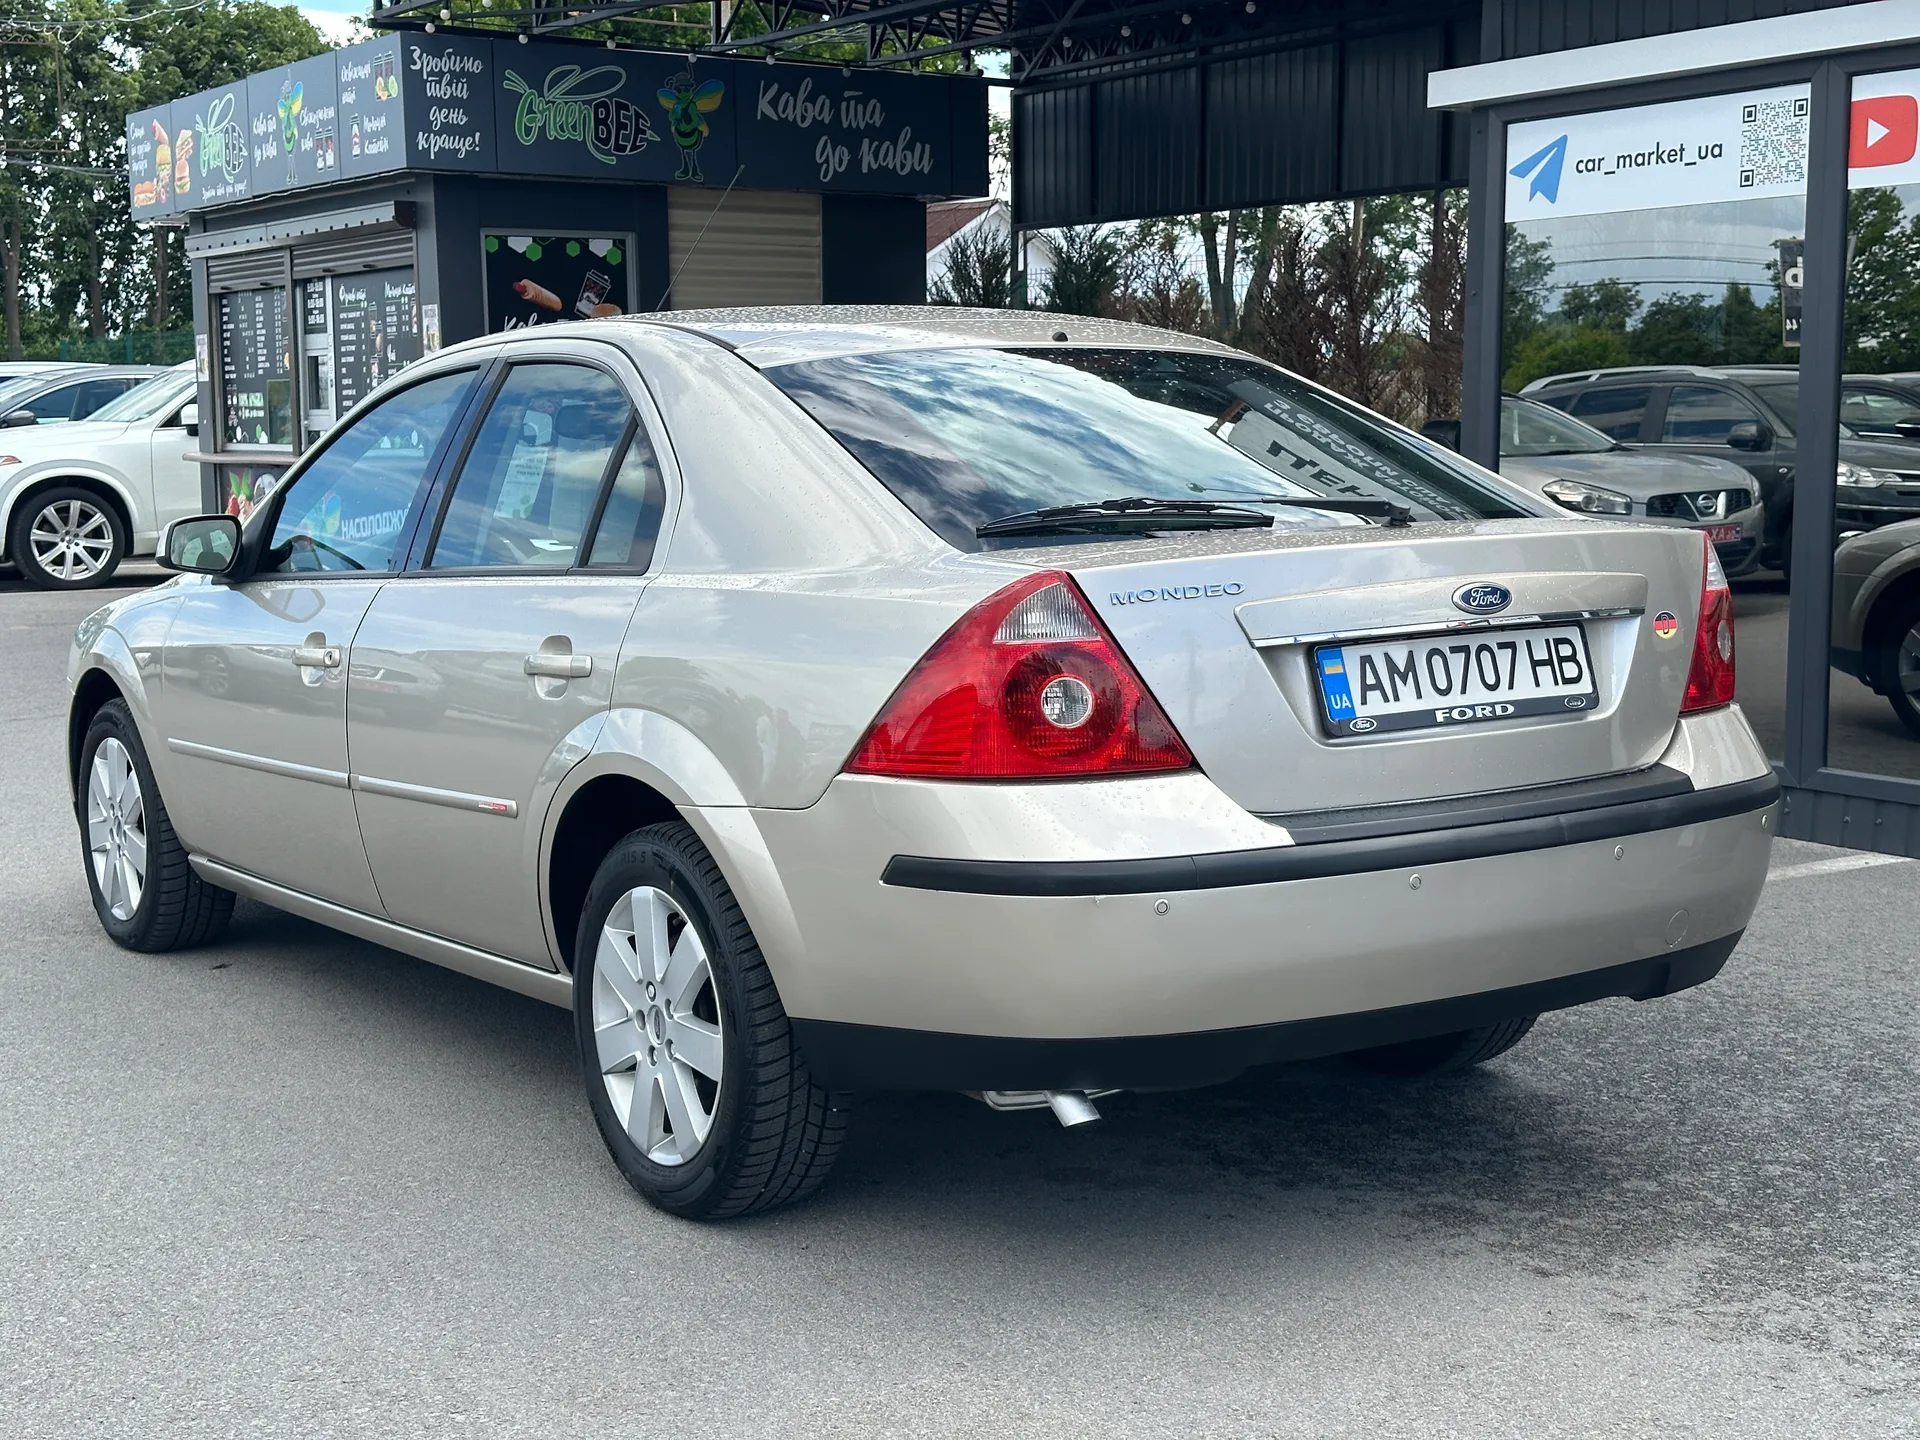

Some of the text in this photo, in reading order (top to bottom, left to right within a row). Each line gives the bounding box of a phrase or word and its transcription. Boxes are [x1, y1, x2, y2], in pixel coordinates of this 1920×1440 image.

[409, 45, 484, 80] Зробимо
[426, 74, 470, 100] твій
[429, 105, 469, 130] день
[756, 77, 886, 130] Кава та
[416, 130, 481, 160] краще!
[815, 126, 934, 183] до кави
[1574, 140, 1724, 176] car_market_ua
[1109, 581, 1246, 606] MONDEO
[1469, 587, 1502, 606] Ford
[1358, 636, 1584, 706] AM 0707 HB
[1330, 693, 1352, 711] UA
[1434, 703, 1515, 723] FORD
